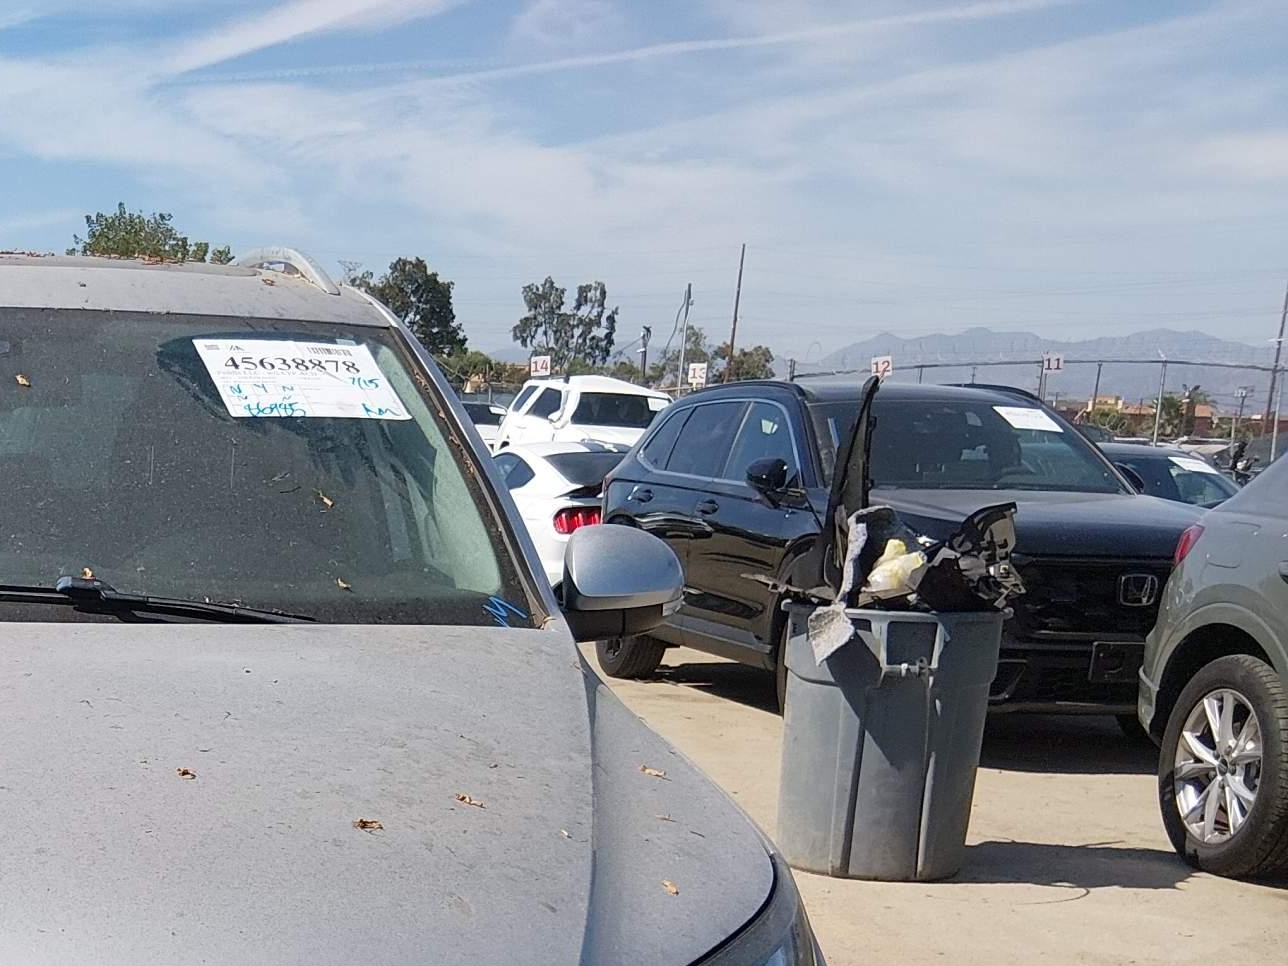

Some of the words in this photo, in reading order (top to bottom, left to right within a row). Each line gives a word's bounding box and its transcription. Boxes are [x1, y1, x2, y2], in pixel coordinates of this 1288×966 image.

[224, 356, 361, 374] 45638878
[531, 357, 549, 372] 14
[872, 359, 891, 374] 12
[1044, 358, 1063, 371] 11
[690, 367, 706, 379] 13
